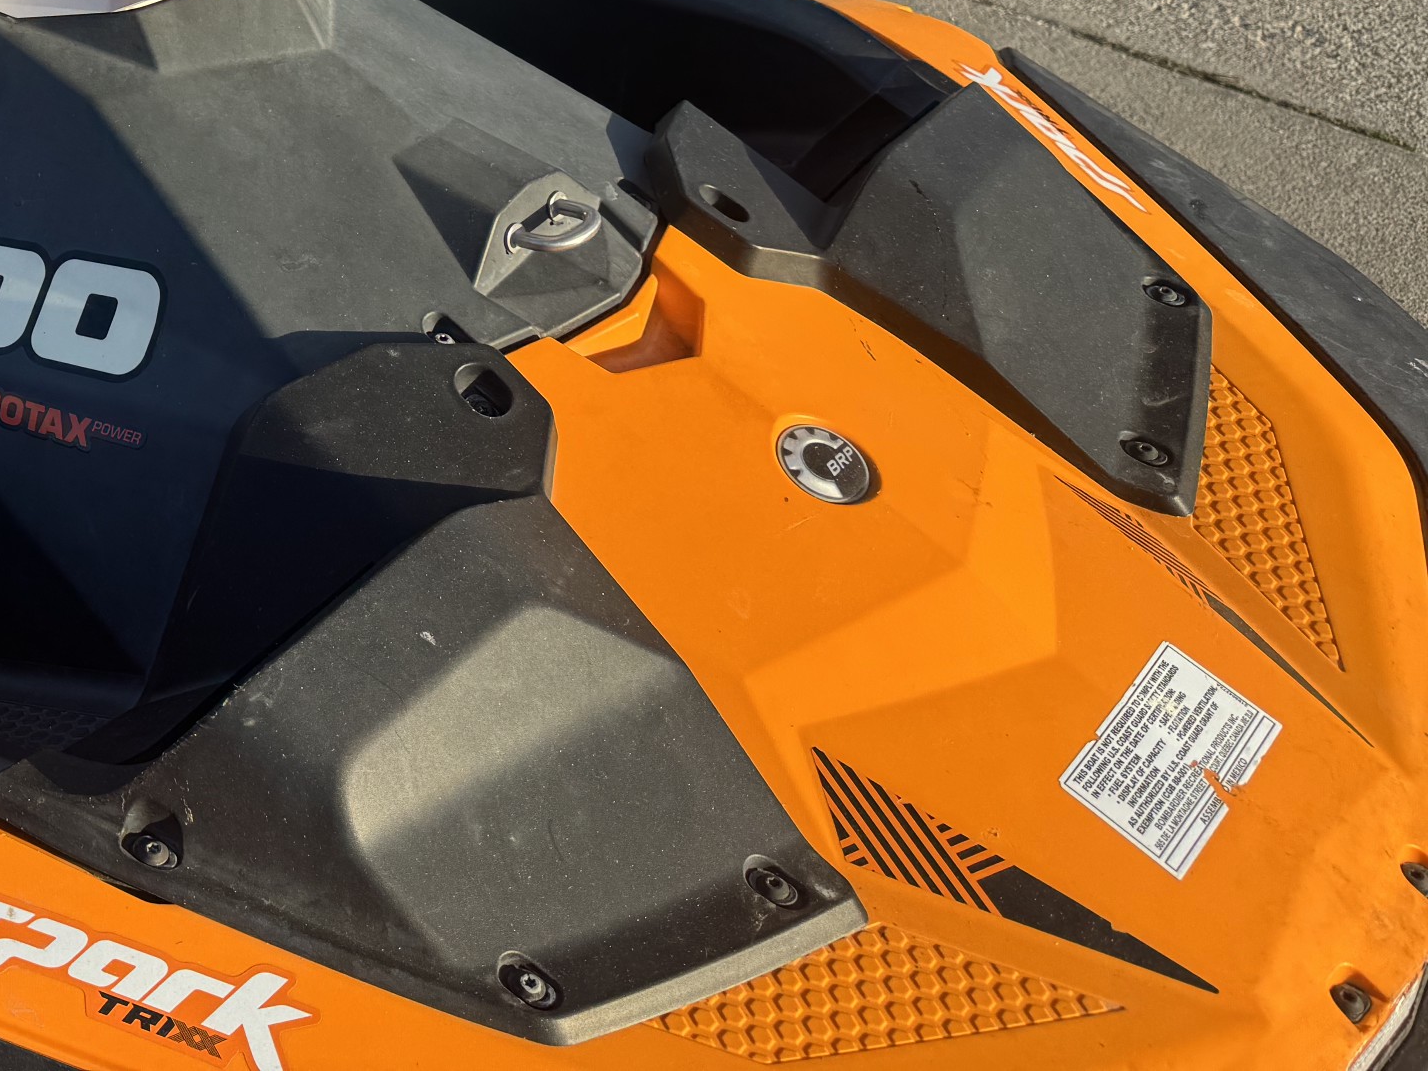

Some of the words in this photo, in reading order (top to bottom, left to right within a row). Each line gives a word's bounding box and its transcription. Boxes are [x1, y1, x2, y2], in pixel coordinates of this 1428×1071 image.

[92, 420, 143, 446] POWER
[826, 446, 854, 476] BRP
[1073, 768, 1088, 785] THIS
[1084, 753, 1100, 771] BOAT
[1095, 746, 1105, 755] IS
[1101, 733, 1114, 748] NOT
[1110, 705, 1135, 736] REQUIRED
[1131, 698, 1140, 708] TO
[1149, 668, 1162, 682] WITH
[1157, 659, 1169, 671] THE
[1082, 756, 1111, 792] FOLLOWING
[1107, 744, 1120, 758] U.S.
[1116, 725, 1134, 747] COAST
[1130, 707, 1148, 727] GUARD
[1143, 688, 1161, 709] STY
[1155, 664, 1179, 692] STANDARDS
[1167, 705, 1190, 732] FLOTATION
[1091, 789, 1101, 799] IN
[1096, 767, 1117, 791] EFFECT
[1113, 758, 1124, 769] ON
[1120, 745, 1133, 760] THE
[1129, 730, 1144, 747] DATE
[1140, 722, 1150, 732] OF
[1108, 776, 1124, 794] FUEL
[1120, 753, 1141, 779] SYSTEM
[1117, 775, 1139, 801] DISPLAY
[1135, 766, 1146, 777] OF
[1142, 738, 1166, 768] CAPACITY
[1127, 815, 1138, 827] AS
[1133, 778, 1164, 818] AUTHORIZED
[1160, 770, 1171, 781] BY
[1166, 758, 1179, 772] U.S.
[1175, 740, 1192, 760] COAST
[1187, 724, 1203, 743] GUARD
[1199, 708, 1214, 726] GRANT
[1209, 701, 1219, 710] OF
[1127, 765, 1160, 808] INFORMATION
[1154, 788, 1186, 830] BOMBARDIER
[1182, 747, 1215, 790] RECREATIONAL
[1210, 722, 1232, 750] PRODUCTS
[1227, 712, 1239, 725] INC.
[1154, 838, 1165, 850] 565
[1160, 830, 1170, 841] DE
[1165, 823, 1175, 833] LA
[1171, 796, 1194, 826] MONTAGNE
[1189, 778, 1207, 799] STREET
[1228, 722, 1244, 741] CANADA
[1225, 777, 1234, 786] IN
[1229, 756, 1248, 780] MEXICO
[1136, 798, 1164, 834] EXEMPTION
[1160, 783, 1177, 801] (CGB
[97, 990, 228, 1060] TRIXX
